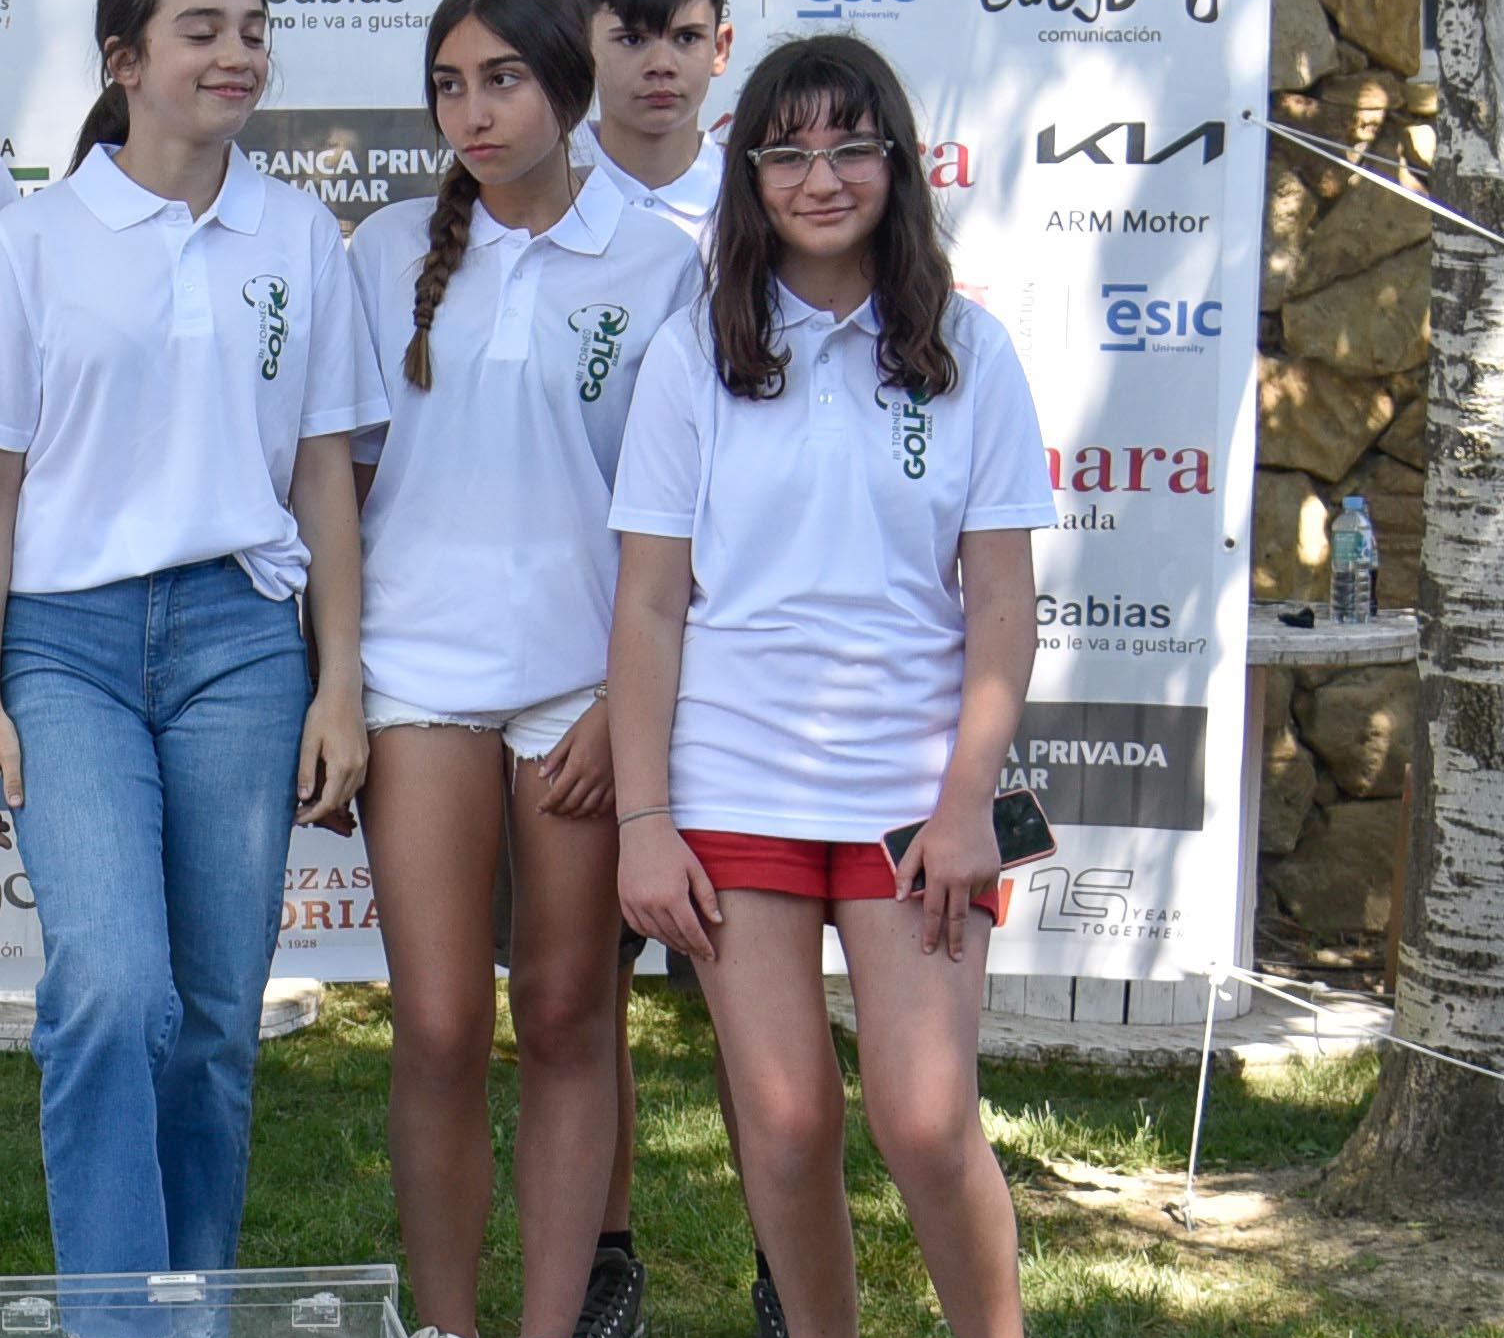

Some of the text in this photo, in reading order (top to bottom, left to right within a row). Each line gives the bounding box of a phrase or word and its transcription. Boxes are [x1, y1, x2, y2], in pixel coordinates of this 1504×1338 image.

[271, 13, 430, 34] no le va a gustar
[1037, 25, 1162, 43] comunicación
[248, 149, 455, 175] BANCA PRIVA
[1046, 210, 1210, 234] ARM Motor
[1103, 295, 1223, 340] esic
[261, 303, 285, 381] GOLF
[577, 328, 592, 367] TORNEO
[1152, 343, 1205, 354] University
[579, 331, 615, 403] GOLF
[892, 401, 902, 446] TORNEO
[903, 403, 926, 480] GOLF
[1047, 446, 1215, 495] ara
[1036, 633, 1207, 657] no le va a gustar?
[1028, 739, 1168, 768] PRIVADA
[1132, 909, 1182, 922] YEAR
[288, 939, 317, 950] 1928
